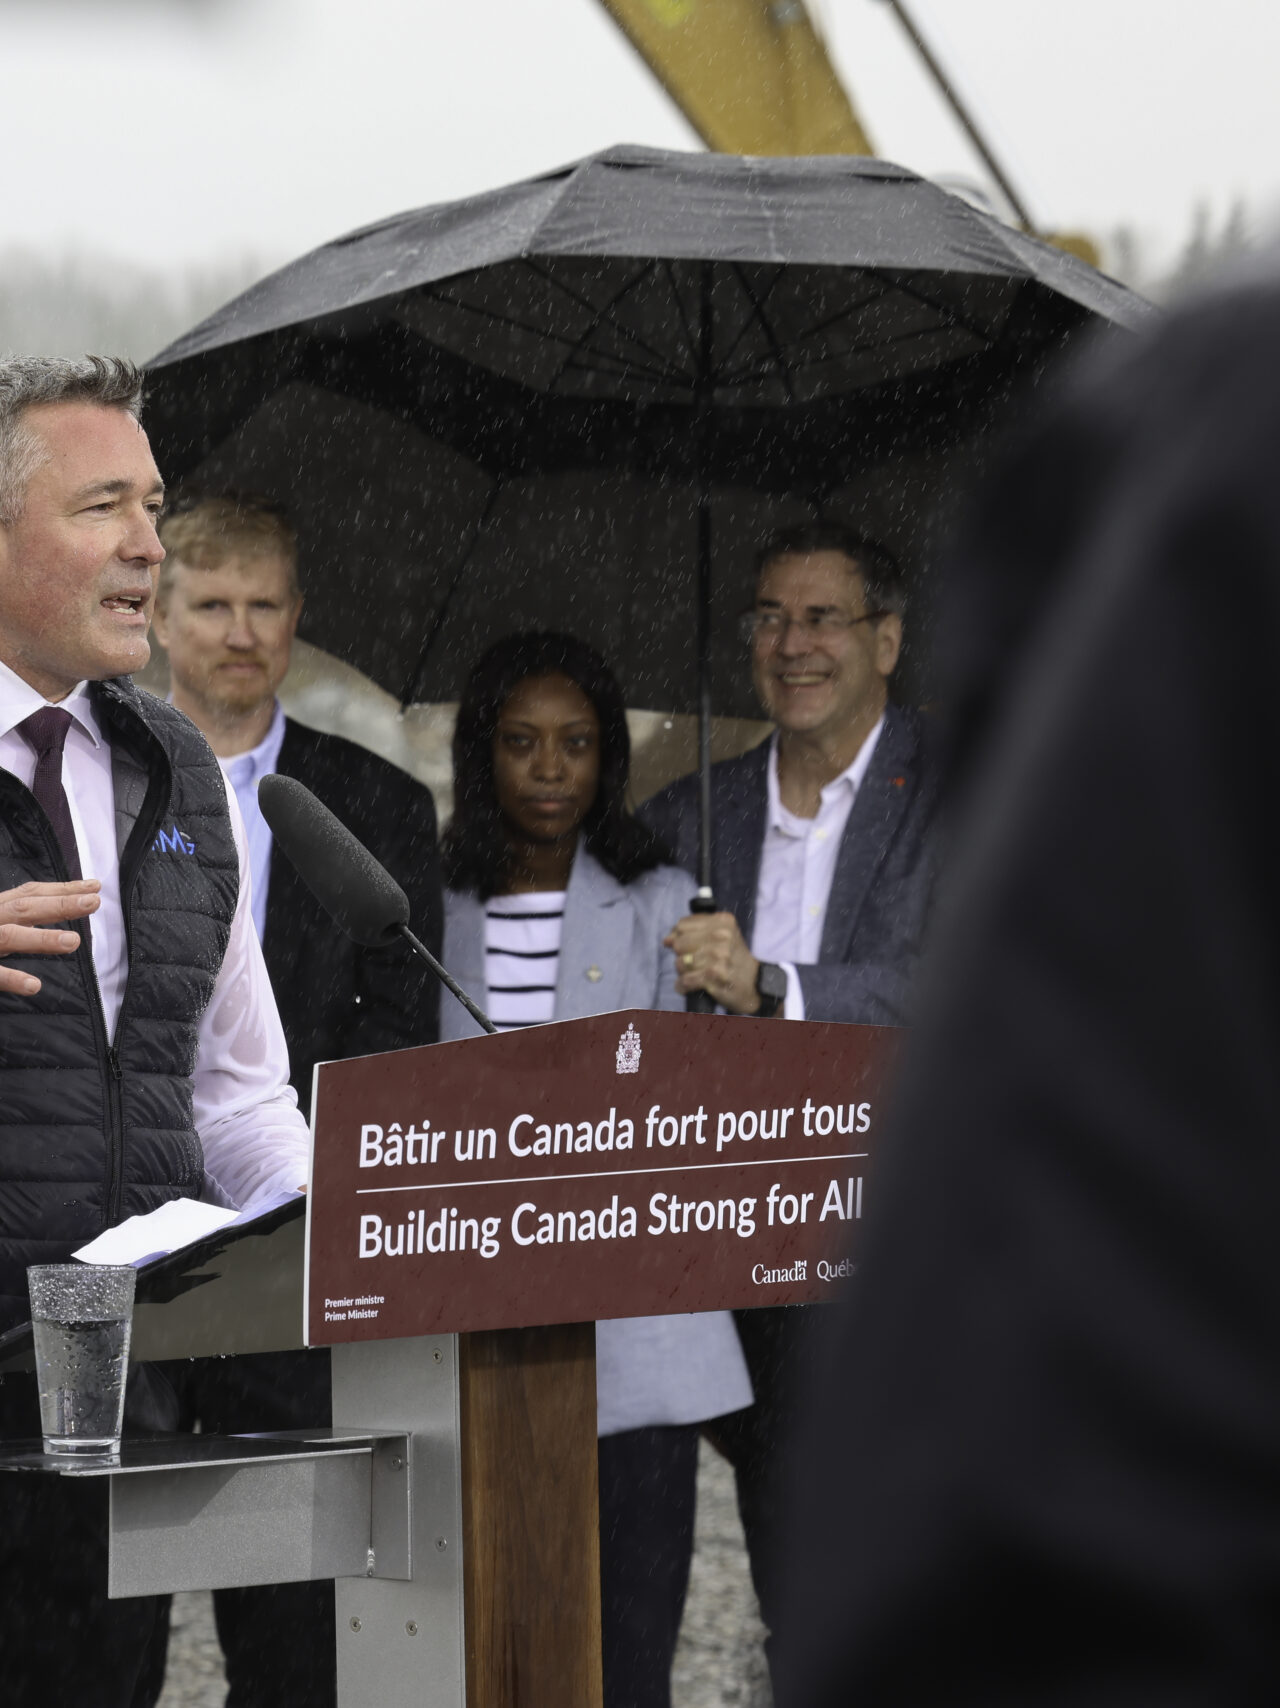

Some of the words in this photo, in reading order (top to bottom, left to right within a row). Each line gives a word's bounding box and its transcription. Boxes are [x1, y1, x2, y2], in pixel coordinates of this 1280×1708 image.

[359, 1119, 446, 1169] Bâtir
[454, 1127, 497, 1162] un
[508, 1107, 635, 1158] Canada
[645, 1104, 709, 1148] fort
[715, 1107, 795, 1153] pour
[801, 1097, 871, 1137] tous
[358, 1207, 502, 1259] Building
[511, 1194, 637, 1246] Canada
[647, 1192, 758, 1238] Strong
[766, 1183, 815, 1226] for
[818, 1176, 864, 1222] All
[751, 1259, 808, 1285] Canada
[816, 1258, 858, 1282] Québ
[324, 1296, 354, 1309] Premier
[354, 1294, 385, 1306] ministre
[324, 1311, 347, 1322] Prime
[347, 1308, 379, 1320] Minister
